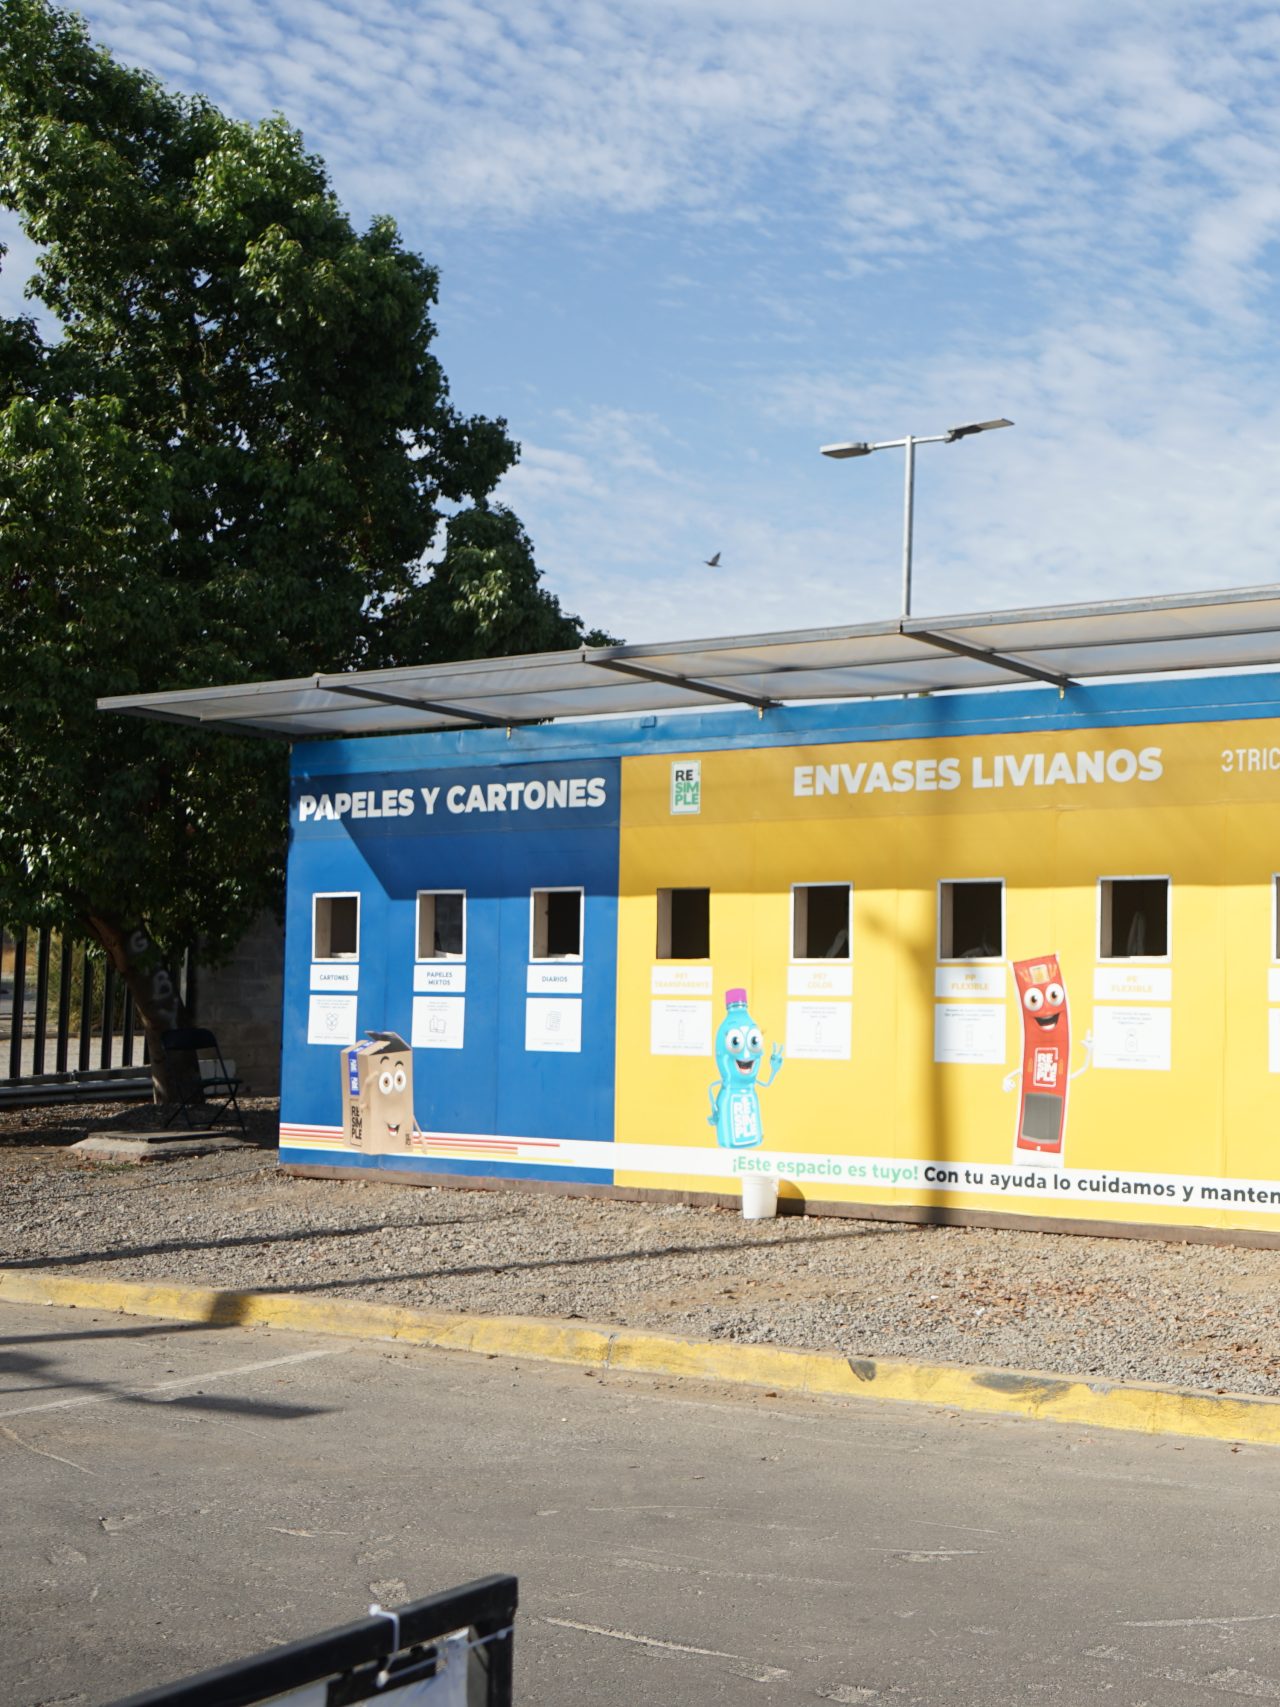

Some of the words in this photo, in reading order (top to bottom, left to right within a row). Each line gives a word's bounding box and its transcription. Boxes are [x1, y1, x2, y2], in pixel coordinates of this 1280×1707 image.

[675, 769, 694, 782] RE
[793, 757, 961, 797] ENVASES
[972, 747, 1163, 788] LIVIANOS
[298, 788, 415, 822] PAPELES
[420, 787, 440, 815] Y
[446, 777, 607, 814] CARTONES
[675, 781, 699, 793] SIM
[675, 793, 699, 806] PLE
[732, 1156, 771, 1172] ¡Este
[776, 1159, 842, 1176] espacio
[848, 1164, 867, 1177] es
[872, 1163, 918, 1183] tuyo!
[924, 1166, 958, 1184] Con
[964, 1170, 984, 1185] tu
[990, 1173, 1047, 1190] ayuda
[1053, 1174, 1071, 1191] lo
[1077, 1175, 1176, 1197] cuidamos
[1182, 1185, 1194, 1202] y
